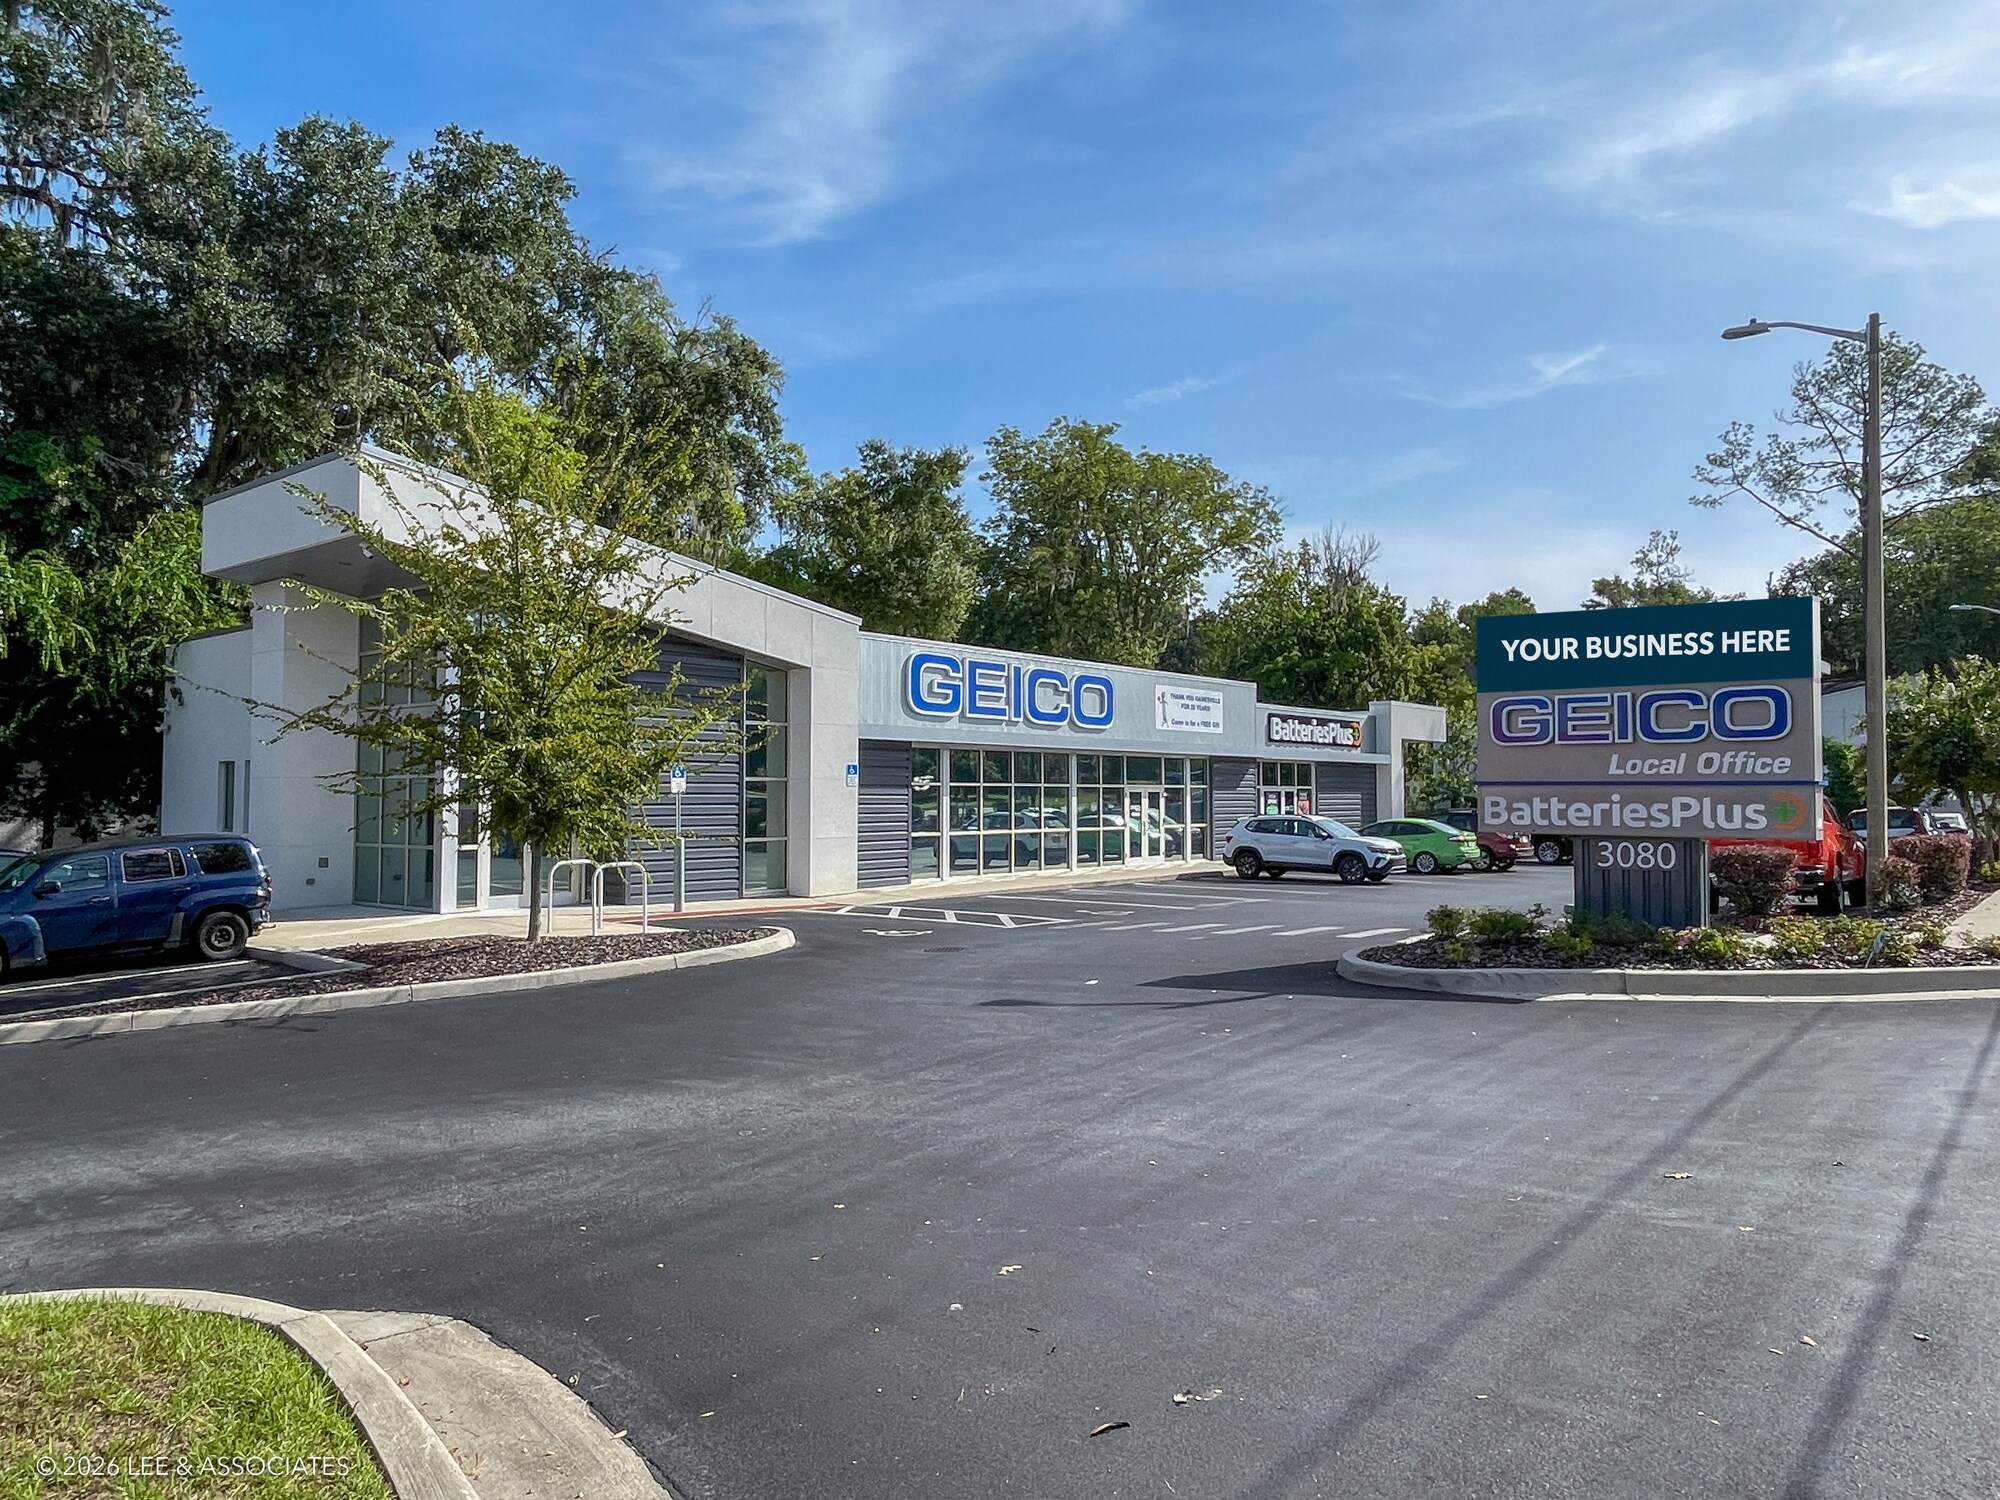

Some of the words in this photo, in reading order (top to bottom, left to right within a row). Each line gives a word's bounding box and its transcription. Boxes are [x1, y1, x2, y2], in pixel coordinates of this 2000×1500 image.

[1501, 638, 1579, 662] YOUR
[1586, 632, 1714, 659] BUSINESS
[1721, 629, 1790, 654] HERE
[906, 651, 1115, 730] GEICO
[1171, 718, 1184, 726] Come
[1201, 720, 1211, 728] FREE
[1490, 684, 1793, 746] GEICO
[1270, 717, 1353, 746] BatteriesPlus
[1608, 752, 1686, 775] Local
[1696, 751, 1792, 774] Office
[1484, 794, 1768, 829] BatteriesPlus
[1597, 841, 1677, 870] 3080
